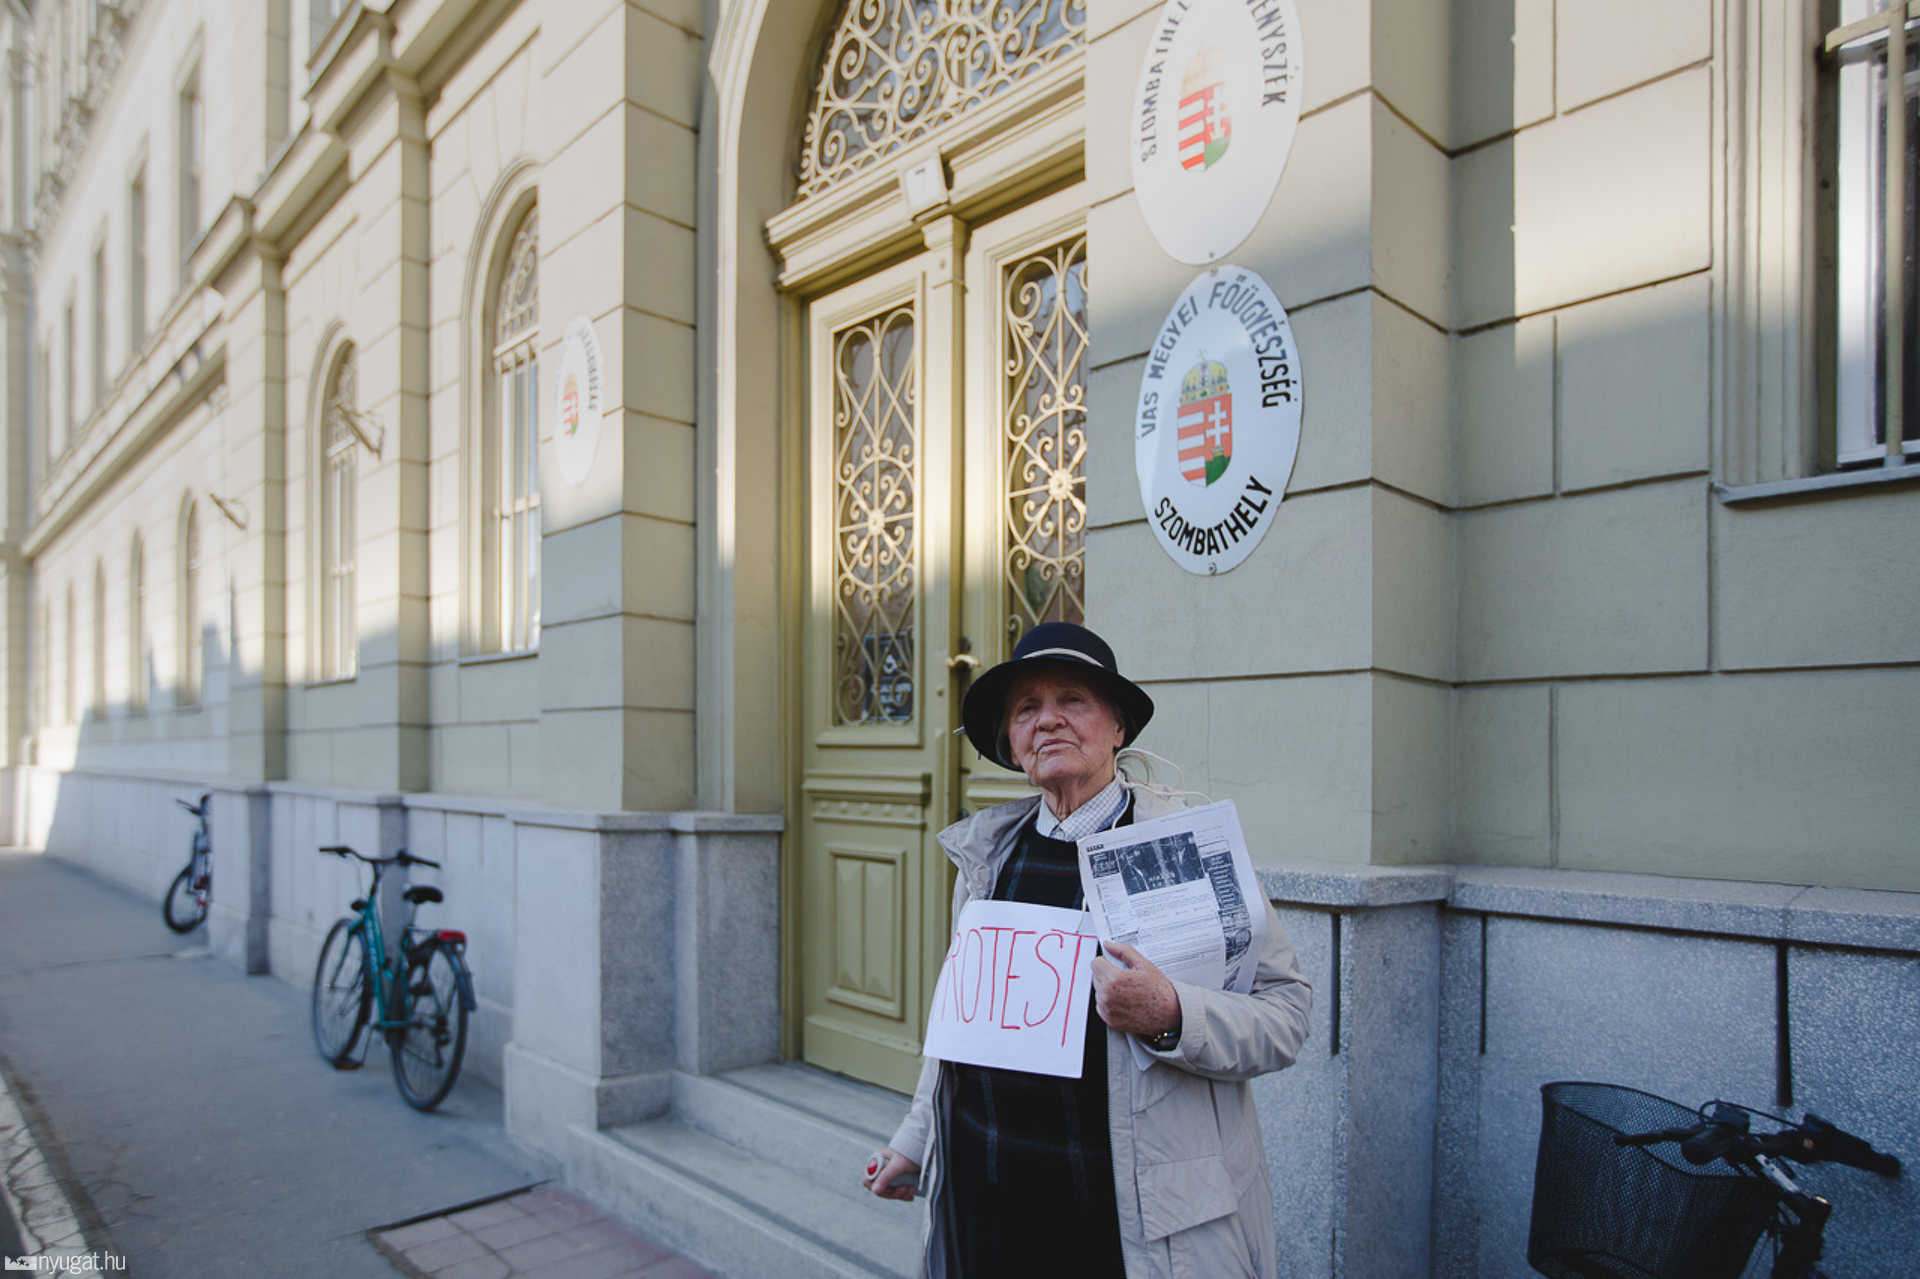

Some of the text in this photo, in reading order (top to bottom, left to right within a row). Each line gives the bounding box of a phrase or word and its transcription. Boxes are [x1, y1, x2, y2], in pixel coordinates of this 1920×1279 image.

[1141, 274, 1297, 437] VAS MEGYEI FŐÜGYÉSZSÉG
[1154, 475, 1273, 556] SZOMBATHELY
[940, 926, 1098, 1048] ROTEST
